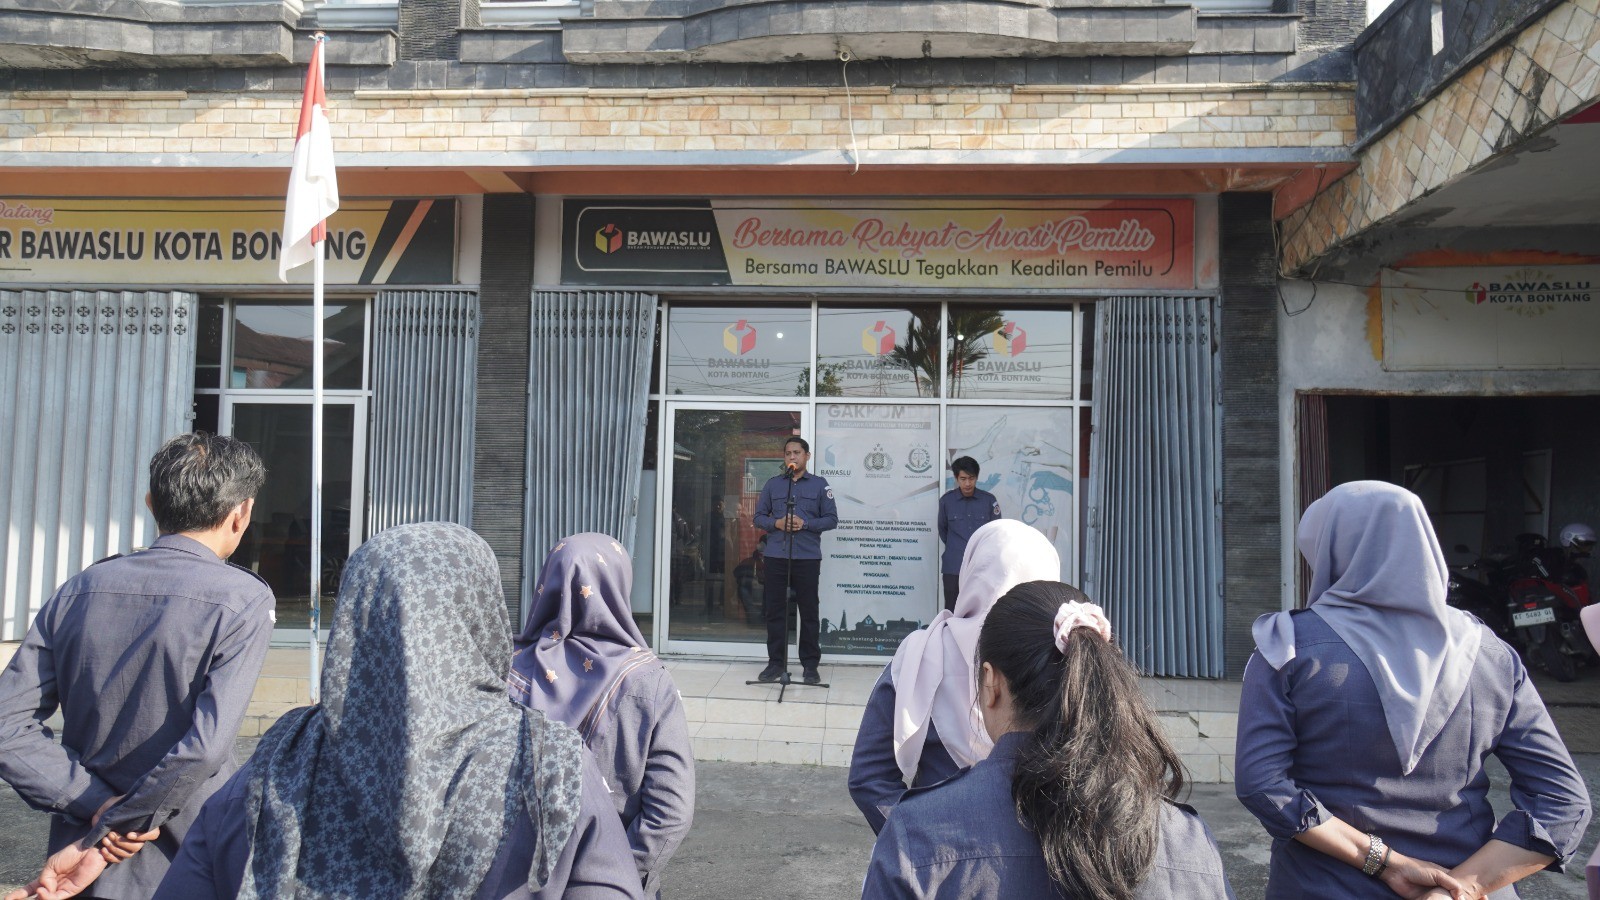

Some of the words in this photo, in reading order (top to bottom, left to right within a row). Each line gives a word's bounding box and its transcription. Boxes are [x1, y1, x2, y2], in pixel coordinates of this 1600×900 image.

[627, 231, 711, 246] BAWASLU
[732, 217, 849, 249] Bersama
[852, 218, 956, 257] Rakyat
[956, 216, 1054, 251] Awasi
[1055, 217, 1153, 253] Pemilu
[21, 230, 145, 260] BAWASLU
[154, 231, 223, 260] KOTA
[232, 231, 366, 260] BONNG
[746, 258, 818, 274] Bersama
[826, 259, 910, 275] BAWASLU
[916, 260, 998, 279] Tegakkan
[1012, 259, 1088, 276] Keadilan
[1096, 260, 1152, 277] Pemilu
[1490, 282, 1590, 292] BAWASLU
[1490, 295, 1523, 303] KOTA
[1528, 294, 1590, 302] BONTANG
[708, 358, 770, 369] BAWASLU
[977, 362, 1041, 372] BAWASLU
